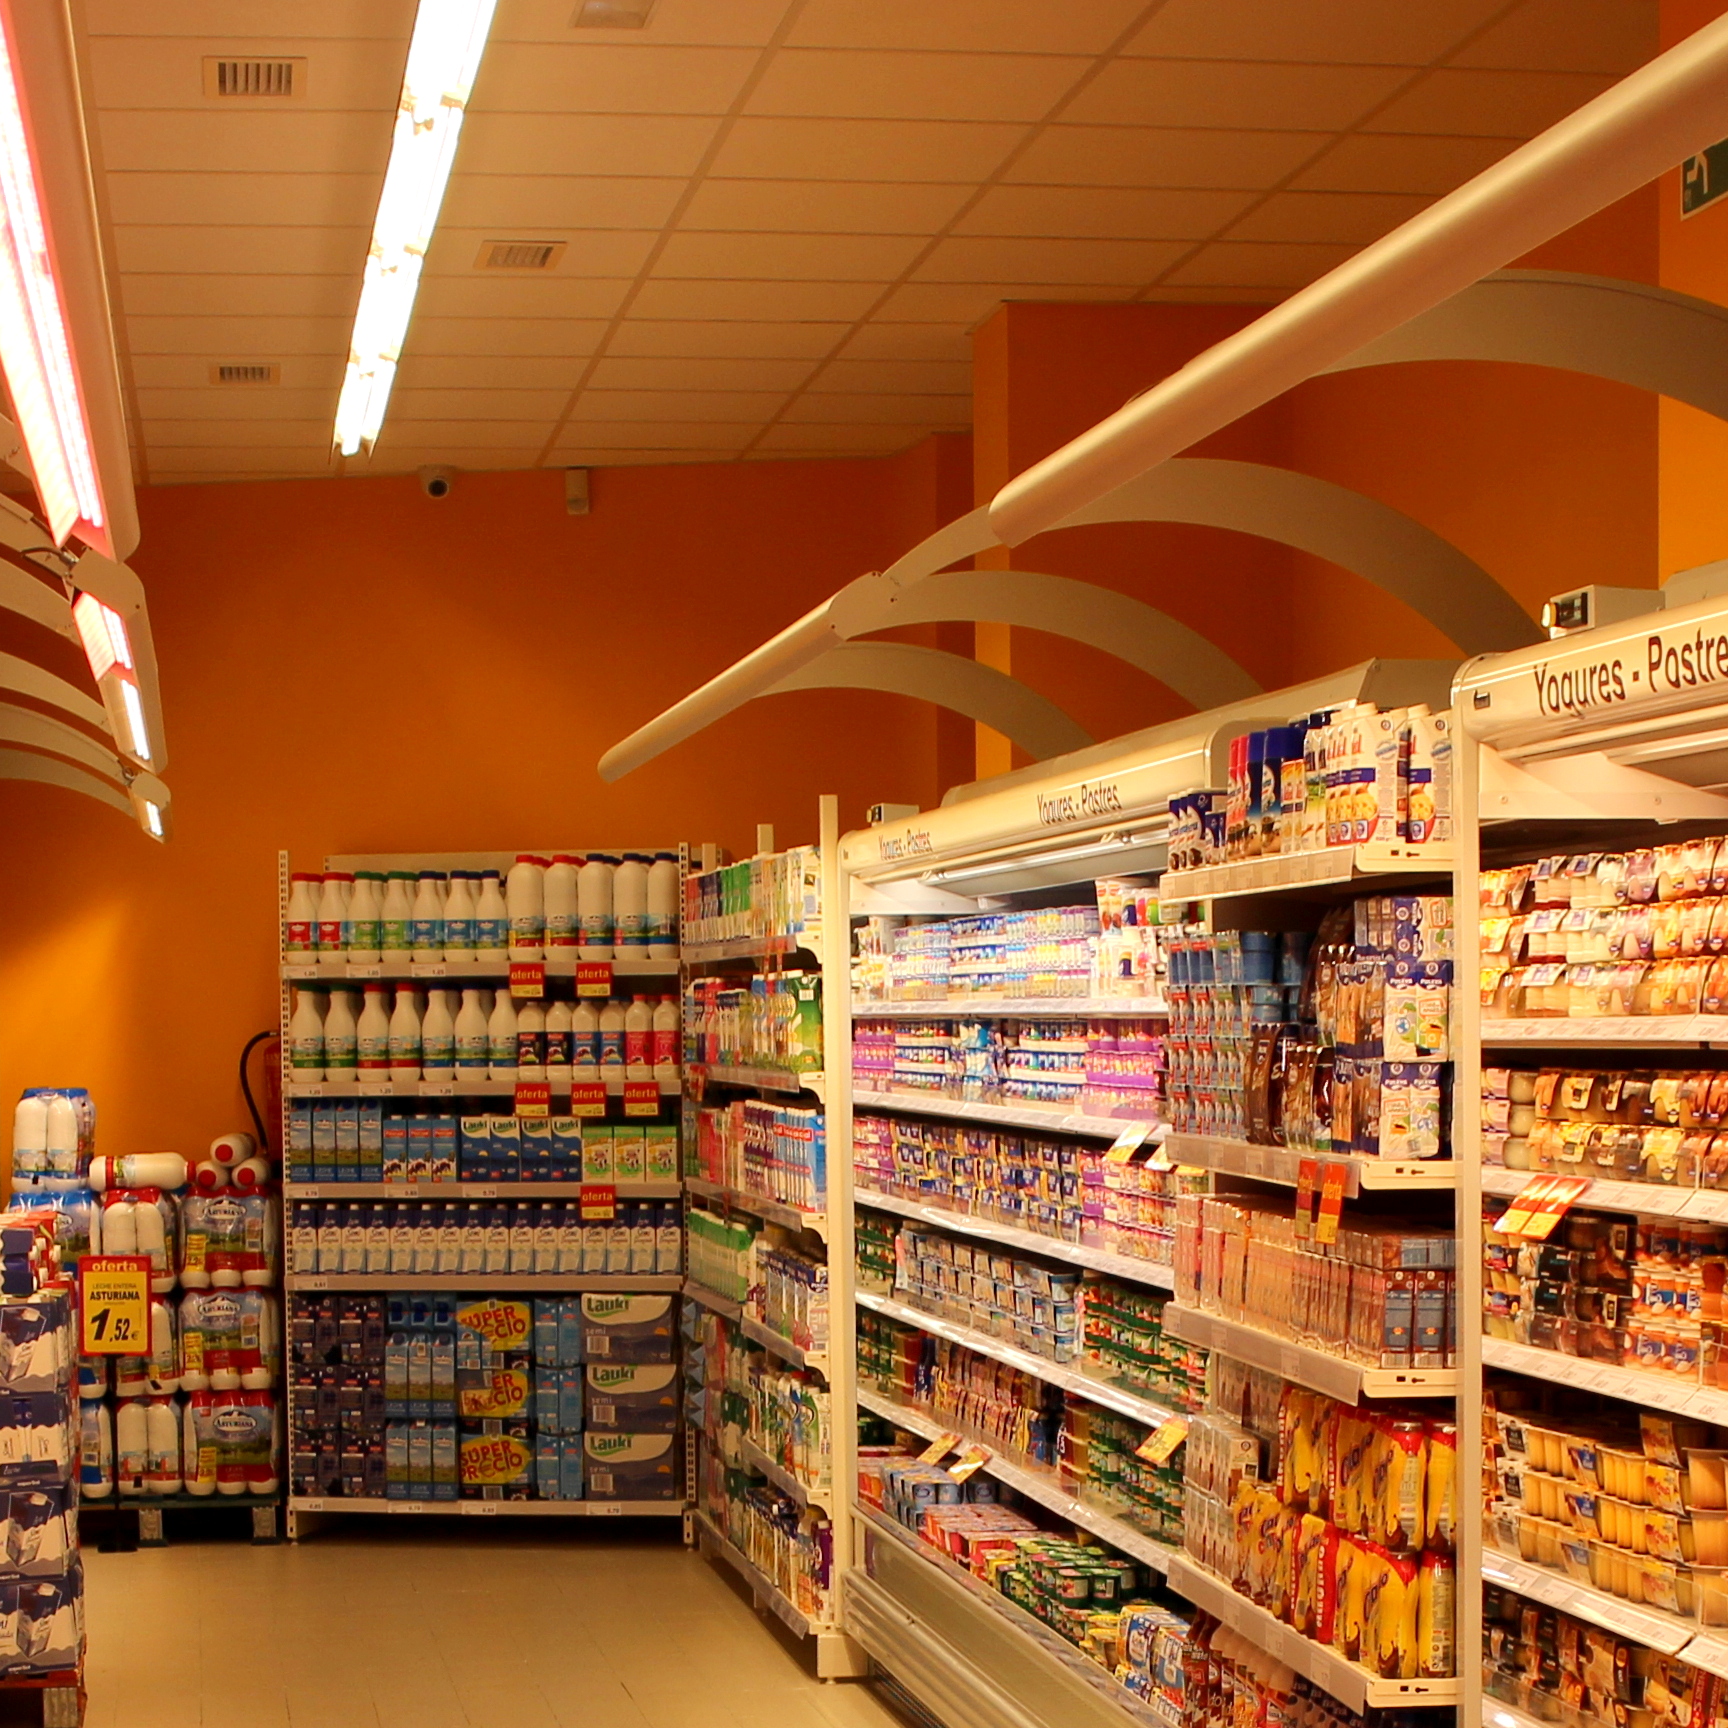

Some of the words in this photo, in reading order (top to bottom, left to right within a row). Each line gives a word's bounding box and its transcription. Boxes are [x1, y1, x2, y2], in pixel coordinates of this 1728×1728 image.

[1081, 784, 1122, 816] Postres
[510, 969, 541, 980] oferta
[577, 968, 608, 979] oferta
[517, 1088, 548, 1100] oferta
[573, 1088, 604, 1100] oferta
[626, 1087, 657, 1099] oferta
[581, 1190, 613, 1201] oferta
[92, 1259, 138, 1272] oferta
[90, 1291, 140, 1301] ASTURIANA
[586, 1297, 628, 1312] Lauki
[593, 1366, 635, 1381] Lauki
[215, 1415, 253, 1427] ASTURIANA
[591, 1436, 632, 1451] Lauki
